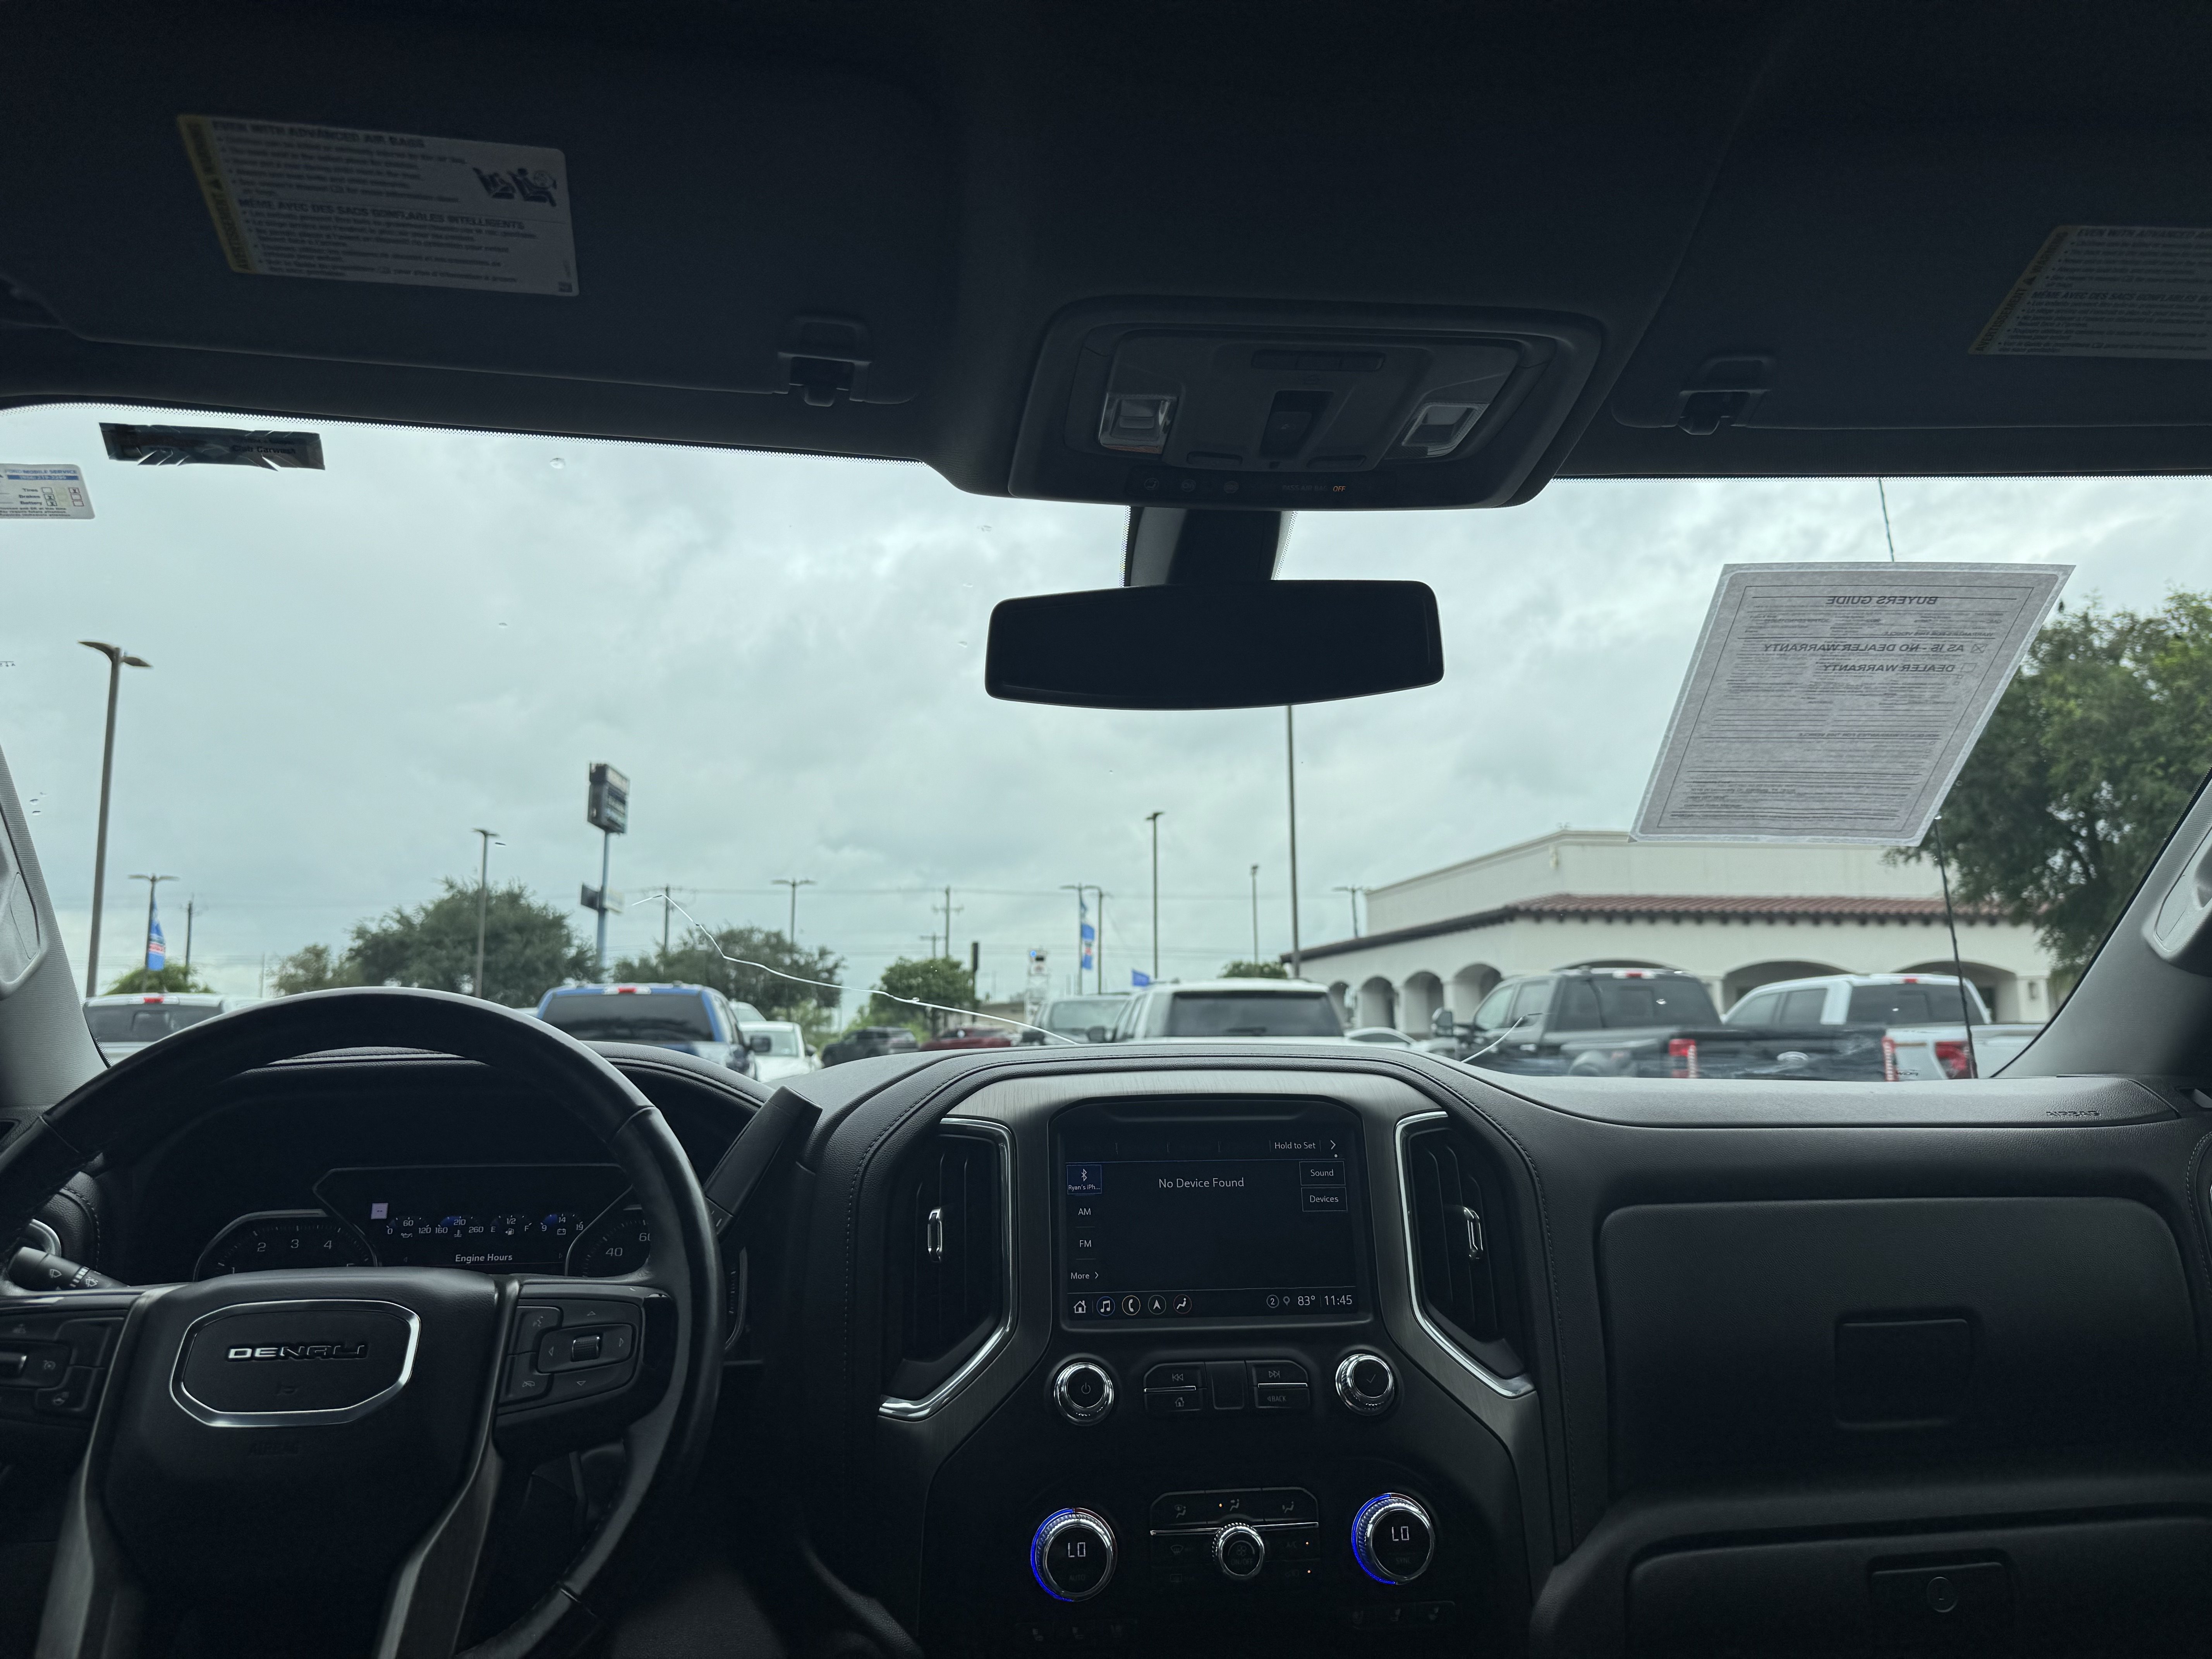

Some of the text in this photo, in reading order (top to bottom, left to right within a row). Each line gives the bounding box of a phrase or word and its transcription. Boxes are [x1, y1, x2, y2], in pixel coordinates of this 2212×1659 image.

[310, 204, 334, 213] DES
[1159, 1177, 1244, 1188] No Device Found
[257, 1242, 266, 1252] 2
[291, 1239, 299, 1249] 3
[323, 1240, 332, 1250] 4
[1079, 1240, 1092, 1248] FM
[605, 1247, 623, 1257] 40
[455, 1254, 485, 1264] Engine
[1297, 1295, 1352, 1305] 83° 11:45
[228, 1345, 366, 1359] DENALI
[1391, 1526, 1410, 1542] LO
[1067, 1541, 1086, 1558] LO
[1230, 1558, 1254, 1566] ON/OFF
